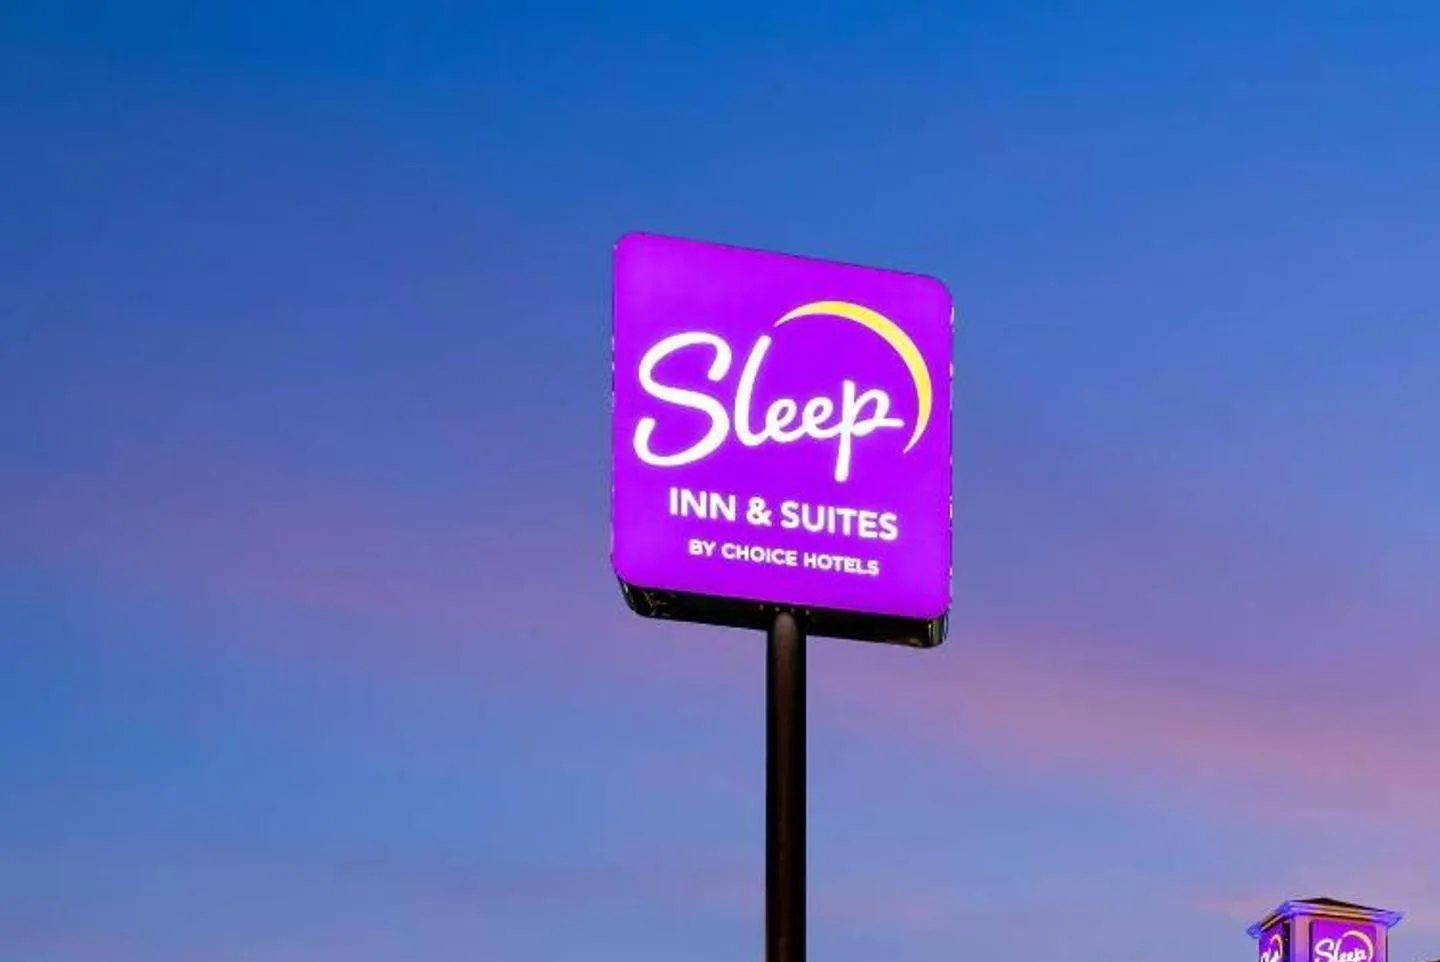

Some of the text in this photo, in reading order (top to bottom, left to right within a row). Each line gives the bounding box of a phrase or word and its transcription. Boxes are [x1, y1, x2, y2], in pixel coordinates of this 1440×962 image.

[633, 331, 905, 482] Sleep
[669, 487, 898, 541] INN & SUITES
[688, 540, 880, 576] BY CHOICE HOTELS
